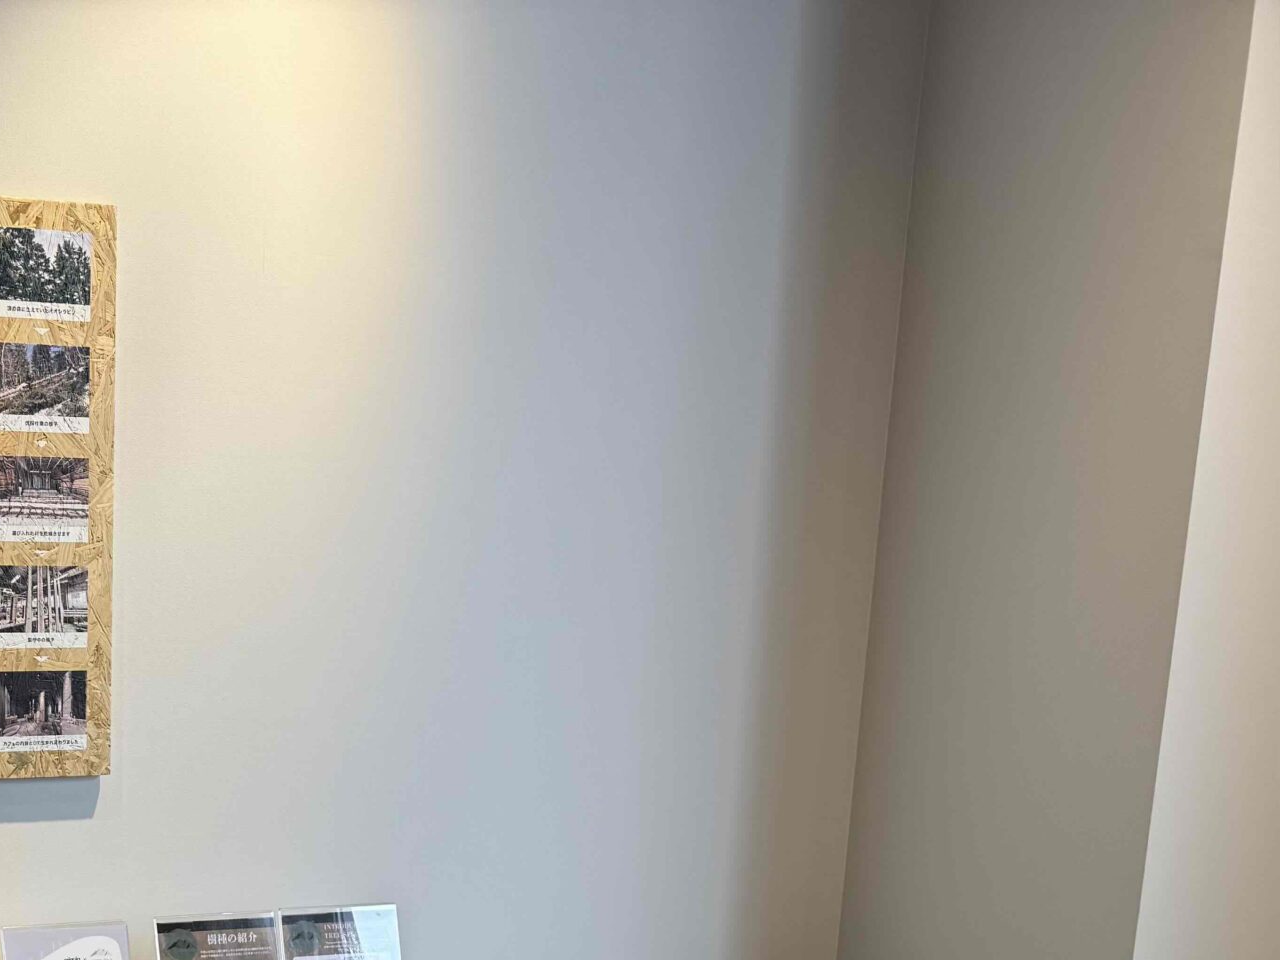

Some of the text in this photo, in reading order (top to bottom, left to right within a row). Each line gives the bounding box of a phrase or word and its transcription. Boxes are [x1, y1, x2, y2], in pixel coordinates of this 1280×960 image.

[207, 931, 257, 945] 樹種の紹介
